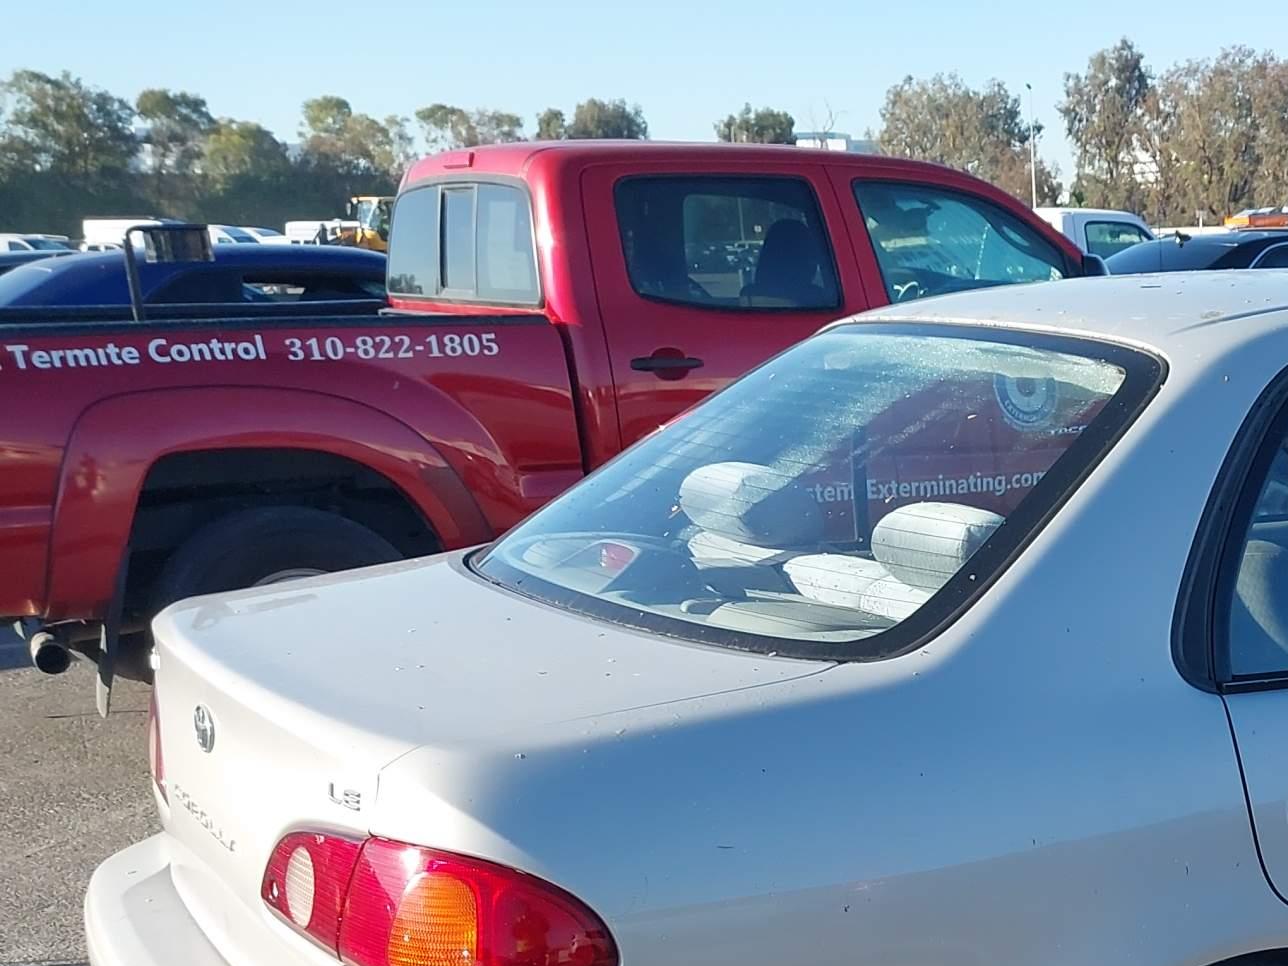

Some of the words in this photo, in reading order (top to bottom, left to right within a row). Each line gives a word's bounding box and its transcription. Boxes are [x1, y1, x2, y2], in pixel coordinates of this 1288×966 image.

[5, 343, 140, 369] Termite
[148, 334, 266, 363] Control
[284, 332, 499, 361] 310-822-1805
